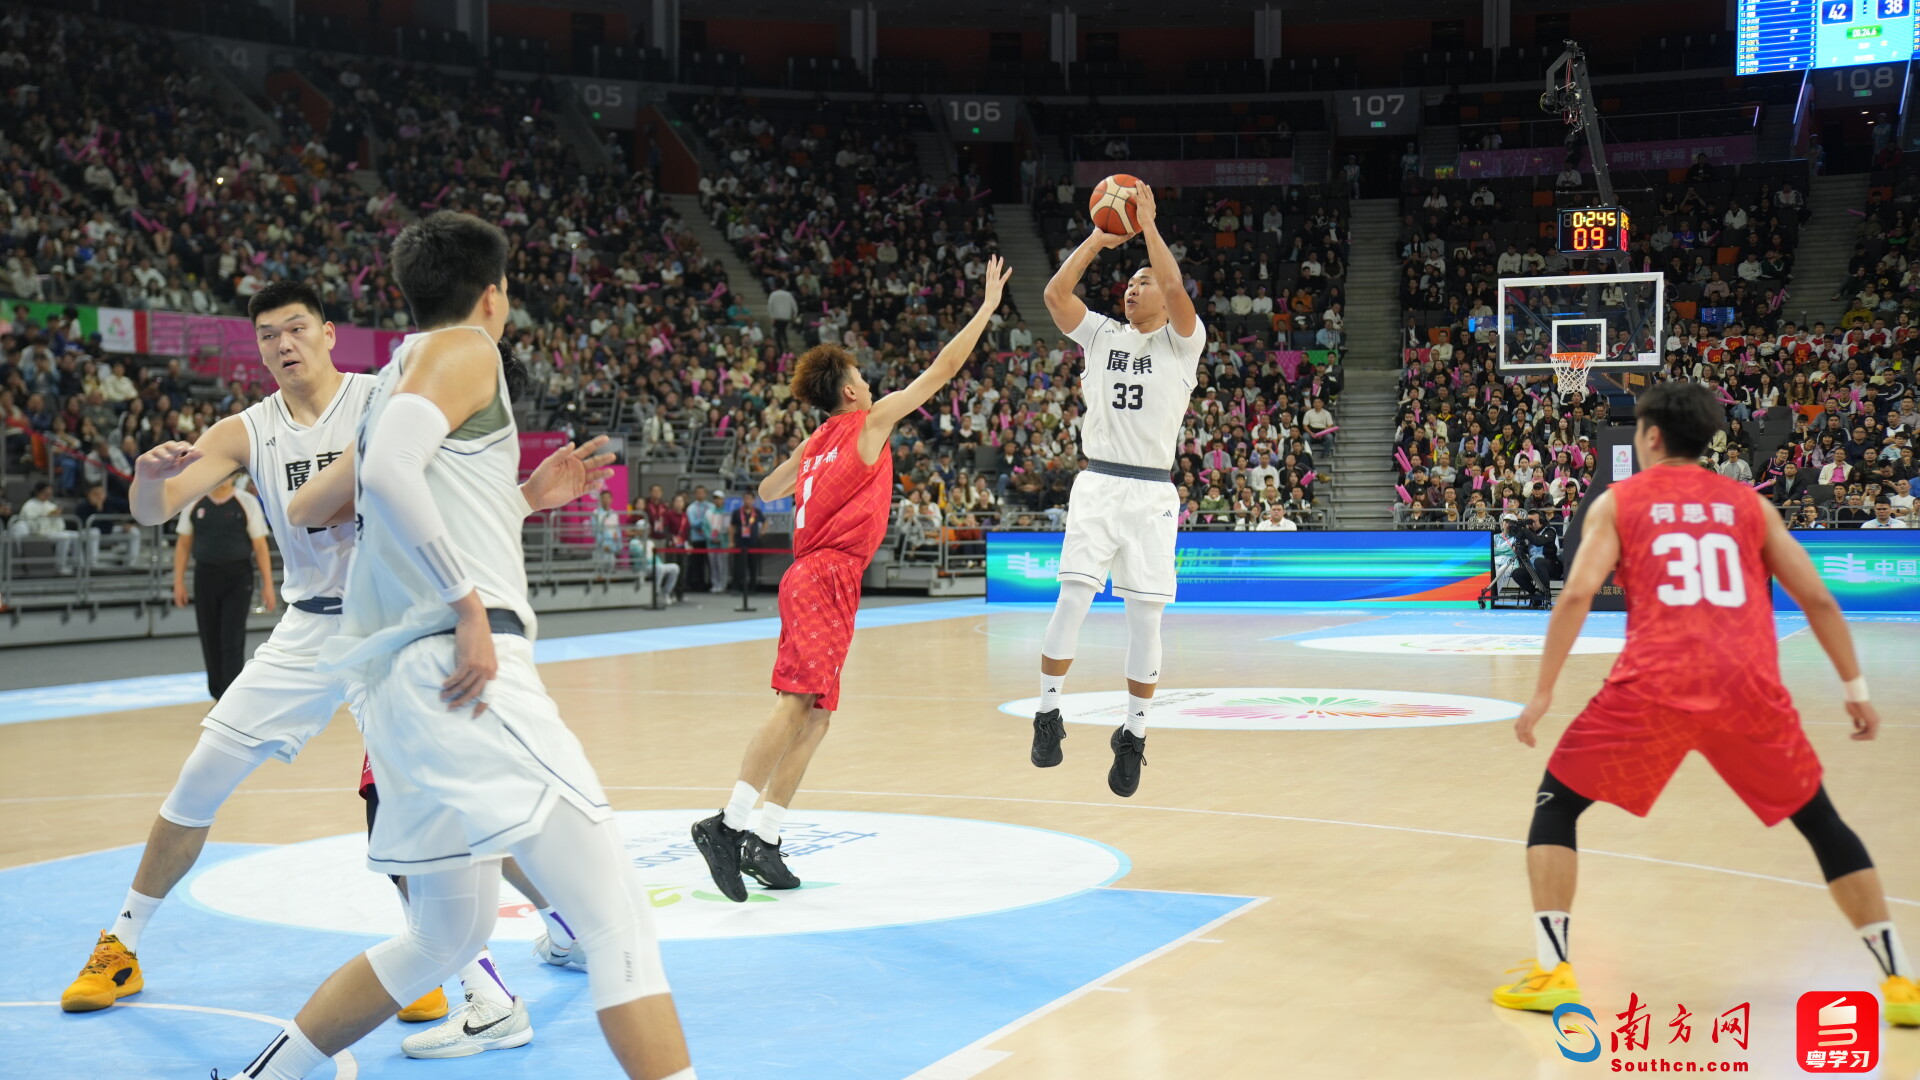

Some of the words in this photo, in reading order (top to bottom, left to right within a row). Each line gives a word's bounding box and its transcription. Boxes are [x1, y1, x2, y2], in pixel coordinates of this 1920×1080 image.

[1828, 3, 1846, 20] 42
[1885, 0, 1903, 15] 38
[1833, 66, 1894, 91] 108
[573, 83, 623, 107] 05
[1352, 94, 1405, 117] 107
[949, 101, 1001, 121] 106
[1573, 227, 1604, 250] 09
[1106, 349, 1152, 375] 廣東
[1112, 382, 1144, 410] 33
[1651, 532, 1747, 608] 30
[1875, 559, 1917, 575] 中国
